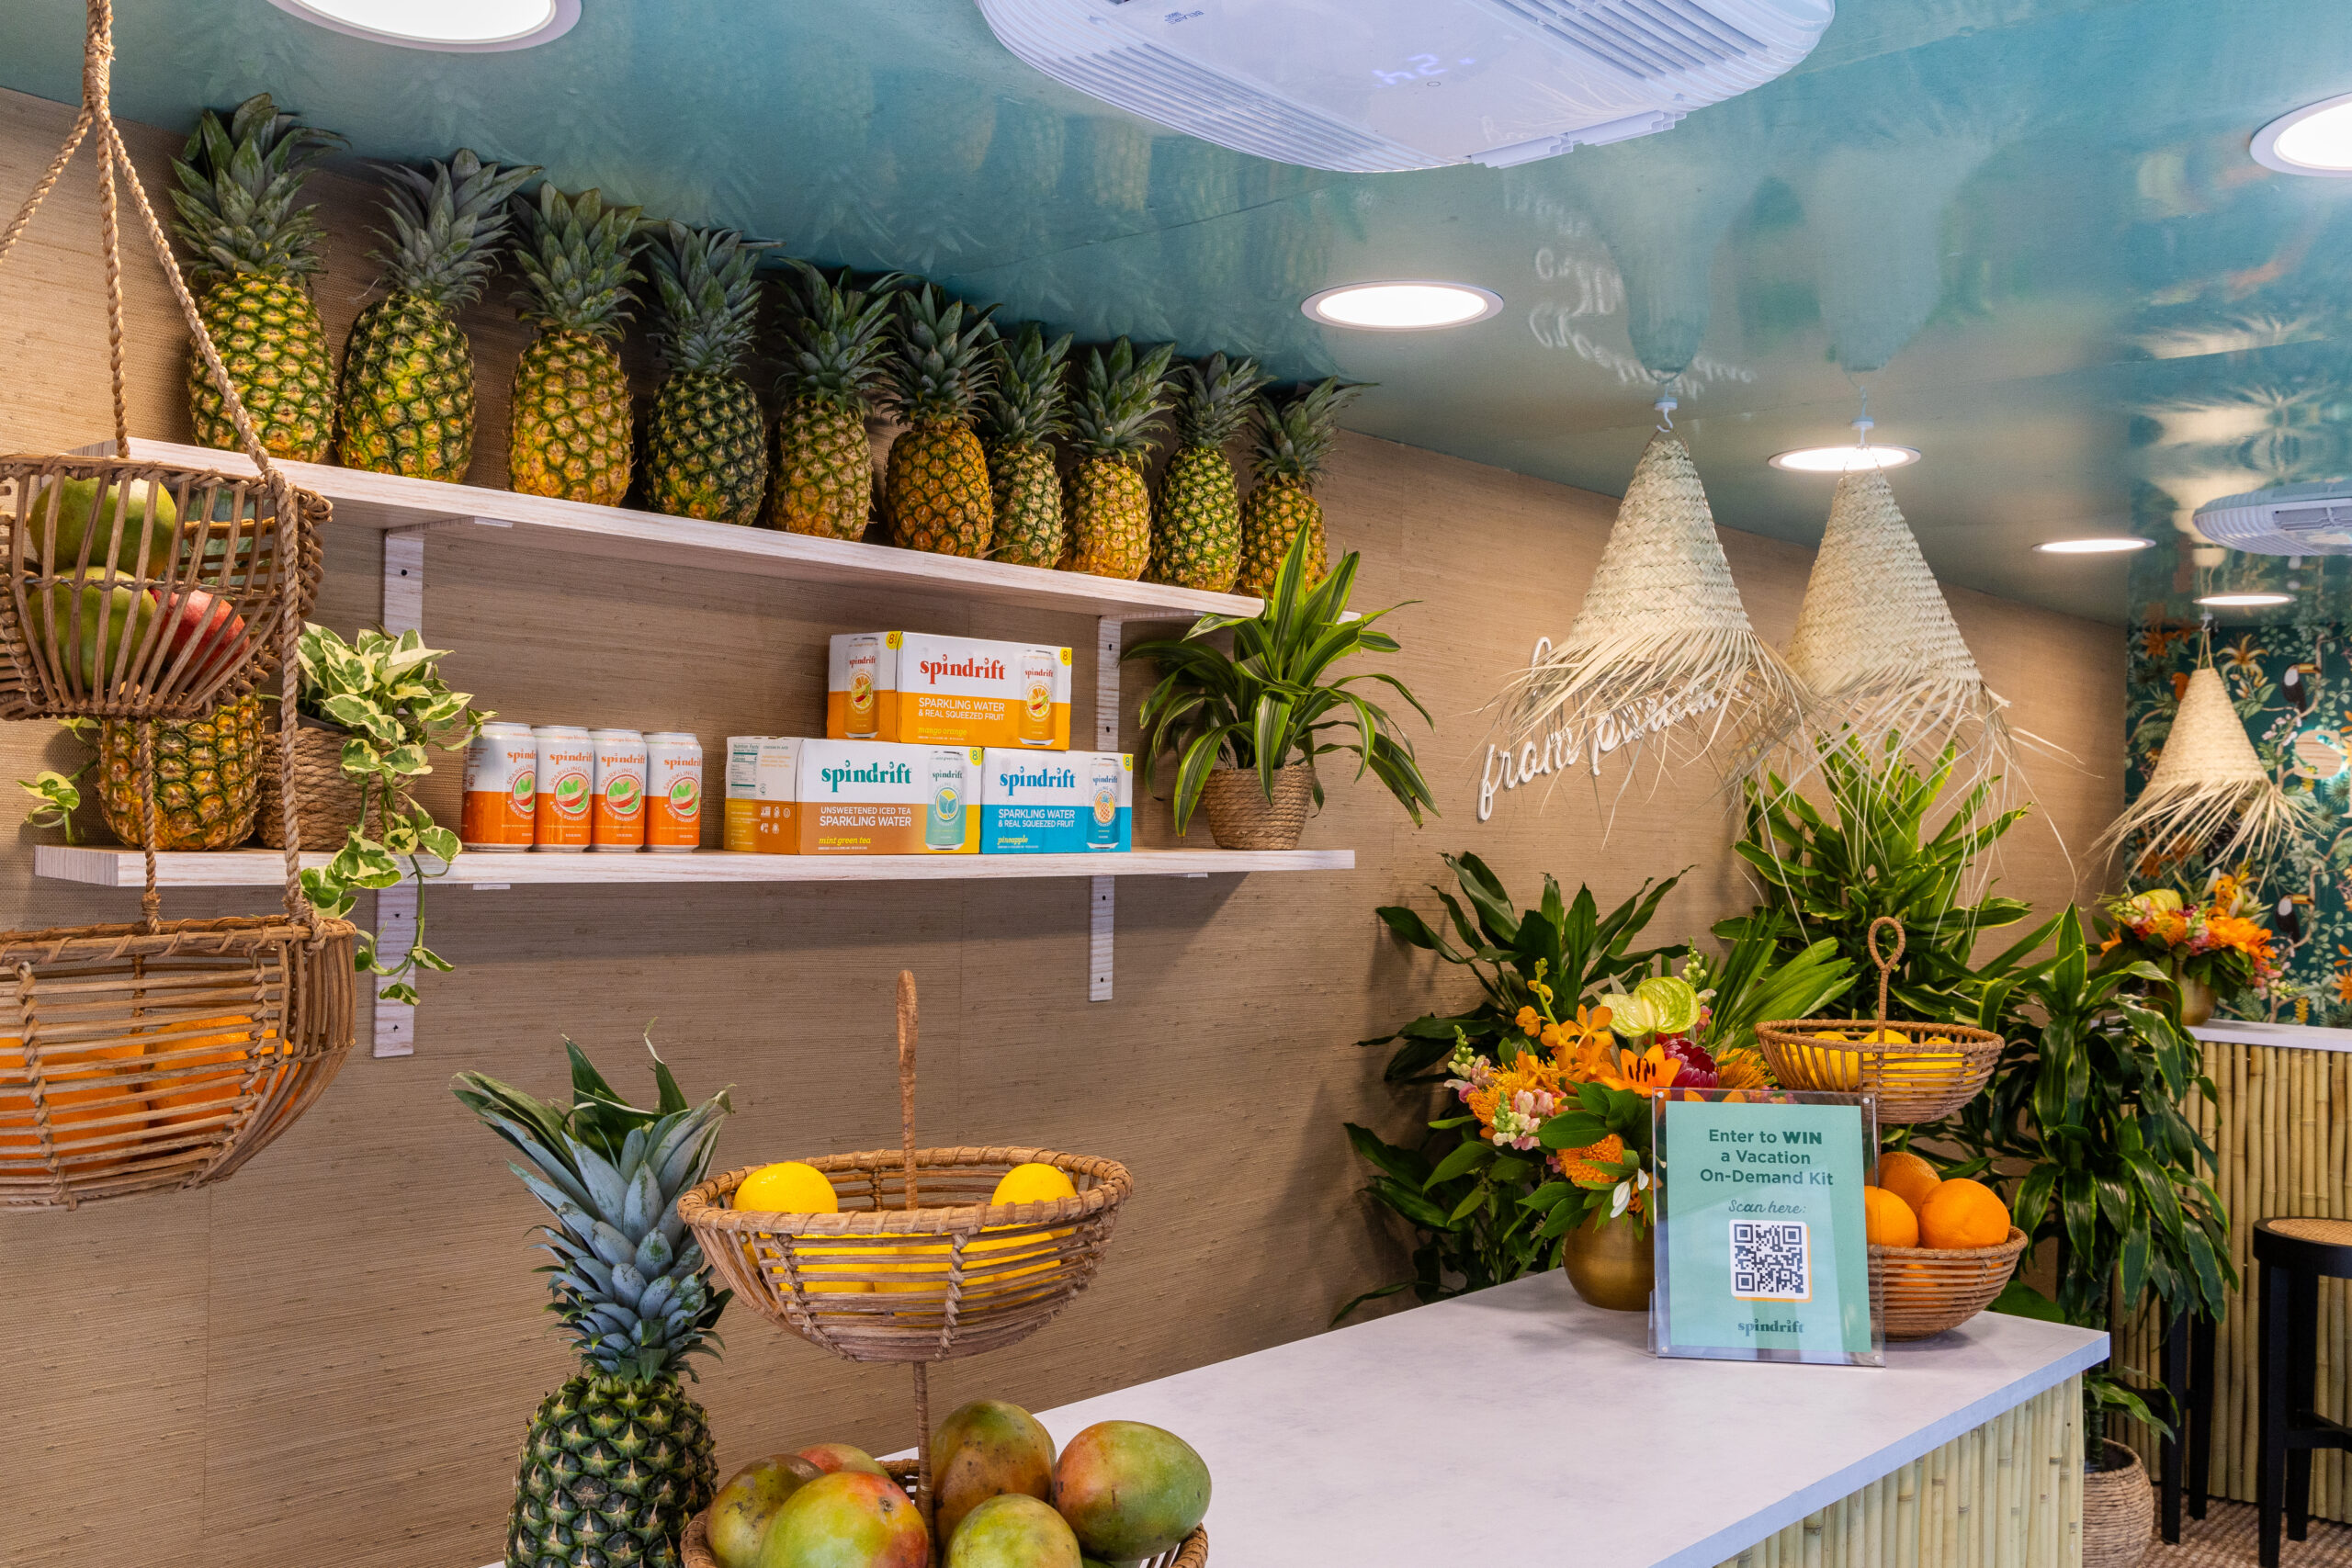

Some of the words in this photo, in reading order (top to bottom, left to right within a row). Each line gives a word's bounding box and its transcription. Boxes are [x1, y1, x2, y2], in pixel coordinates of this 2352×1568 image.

[920, 653, 1005, 685] spindrift
[1024, 668, 1054, 680] spindrift
[919, 697, 971, 710] SPARKLING
[973, 701, 1005, 713] WATER
[925, 709, 944, 718] REAL
[945, 711, 984, 720] SQUEEZED
[821, 760, 912, 793] spindrift
[933, 770, 963, 782] spindrift
[1000, 766, 1075, 796] spindrift
[1092, 774, 1117, 785] spindrift
[820, 807, 877, 815] UNSWEETENED
[998, 808, 1046, 818] SPARKLING
[1046, 809, 1076, 818] WATER
[820, 816, 876, 827] SPARKLING
[878, 817, 912, 827] WATER
[1022, 819, 1056, 828] SQUEEZED
[1057, 819, 1075, 828] FRUIT
[819, 836, 837, 844] mint
[837, 837, 858, 846] green
[997, 834, 1028, 845] pineapple
[1709, 1129, 1754, 1143] Enter
[1759, 1131, 1777, 1144] to
[1782, 1132, 1822, 1145] WIN
[1721, 1152, 1730, 1162] a
[1736, 1150, 1811, 1165] Vacation
[1700, 1168, 1804, 1185] On-Demand
[1809, 1171, 1834, 1186] Kit
[1728, 1199, 1766, 1213] Scan
[1768, 1200, 1807, 1214] here:
[1737, 1318, 1804, 1337] spindrift
